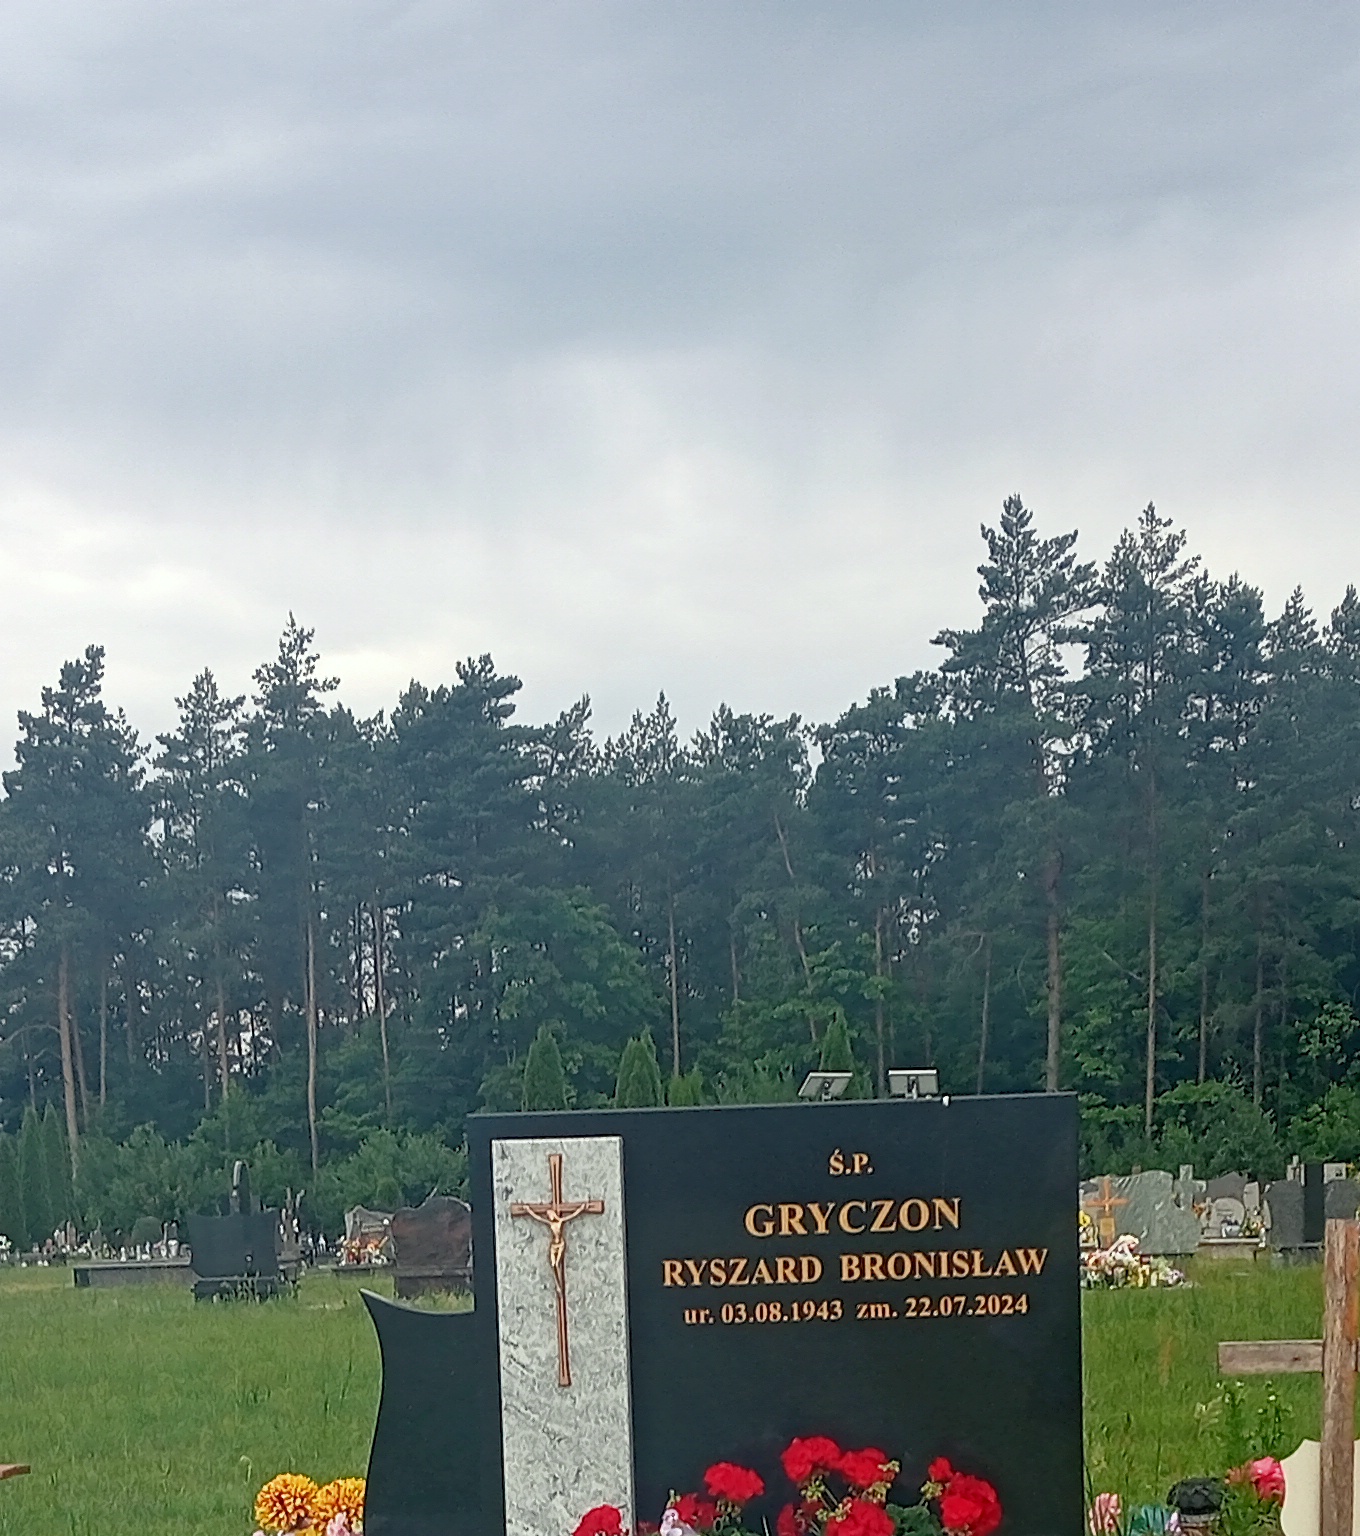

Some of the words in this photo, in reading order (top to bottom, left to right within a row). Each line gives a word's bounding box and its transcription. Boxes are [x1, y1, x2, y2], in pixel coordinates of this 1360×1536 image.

[828, 1148, 874, 1175] Ś.P.
[743, 1197, 962, 1238] GRYCZON
[661, 1256, 823, 1287] RYSZARD
[839, 1247, 1049, 1283] BRONISŁAW
[683, 1305, 715, 1325] ur.
[720, 1300, 844, 1326] 03.08.1943
[855, 1302, 899, 1320] zm.
[904, 1294, 1030, 1319] 22.07.2024
